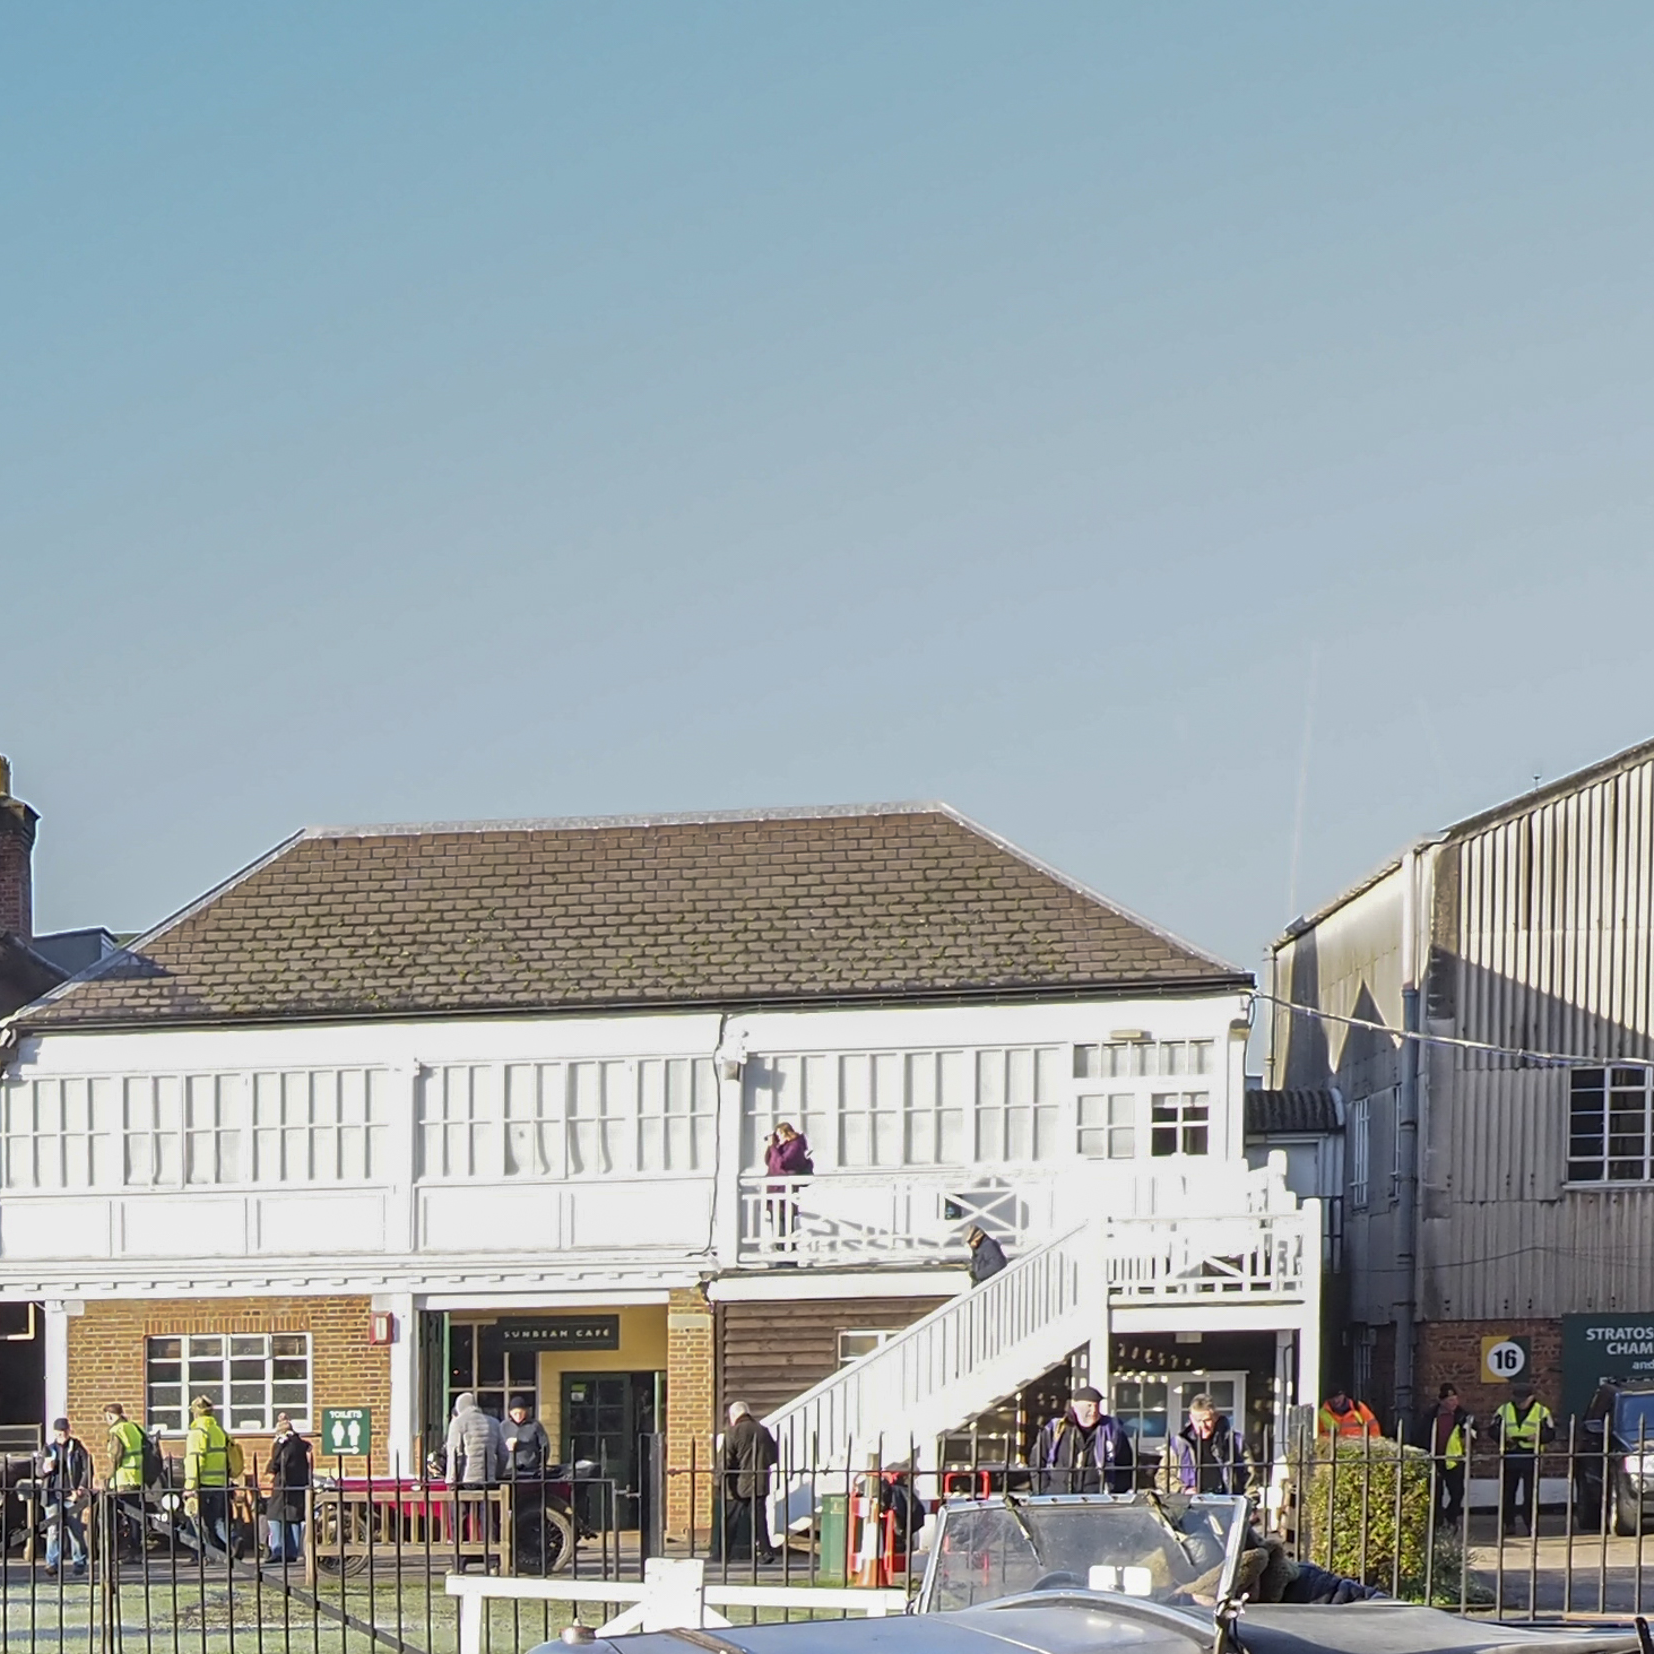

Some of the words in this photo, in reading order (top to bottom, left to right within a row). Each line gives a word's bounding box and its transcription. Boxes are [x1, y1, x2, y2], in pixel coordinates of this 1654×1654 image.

[504, 1329, 568, 1338] SUNBEAM
[575, 1327, 610, 1337] CAFÉ
[1493, 1349, 1517, 1370] 16
[329, 1410, 363, 1419] TOILETS
